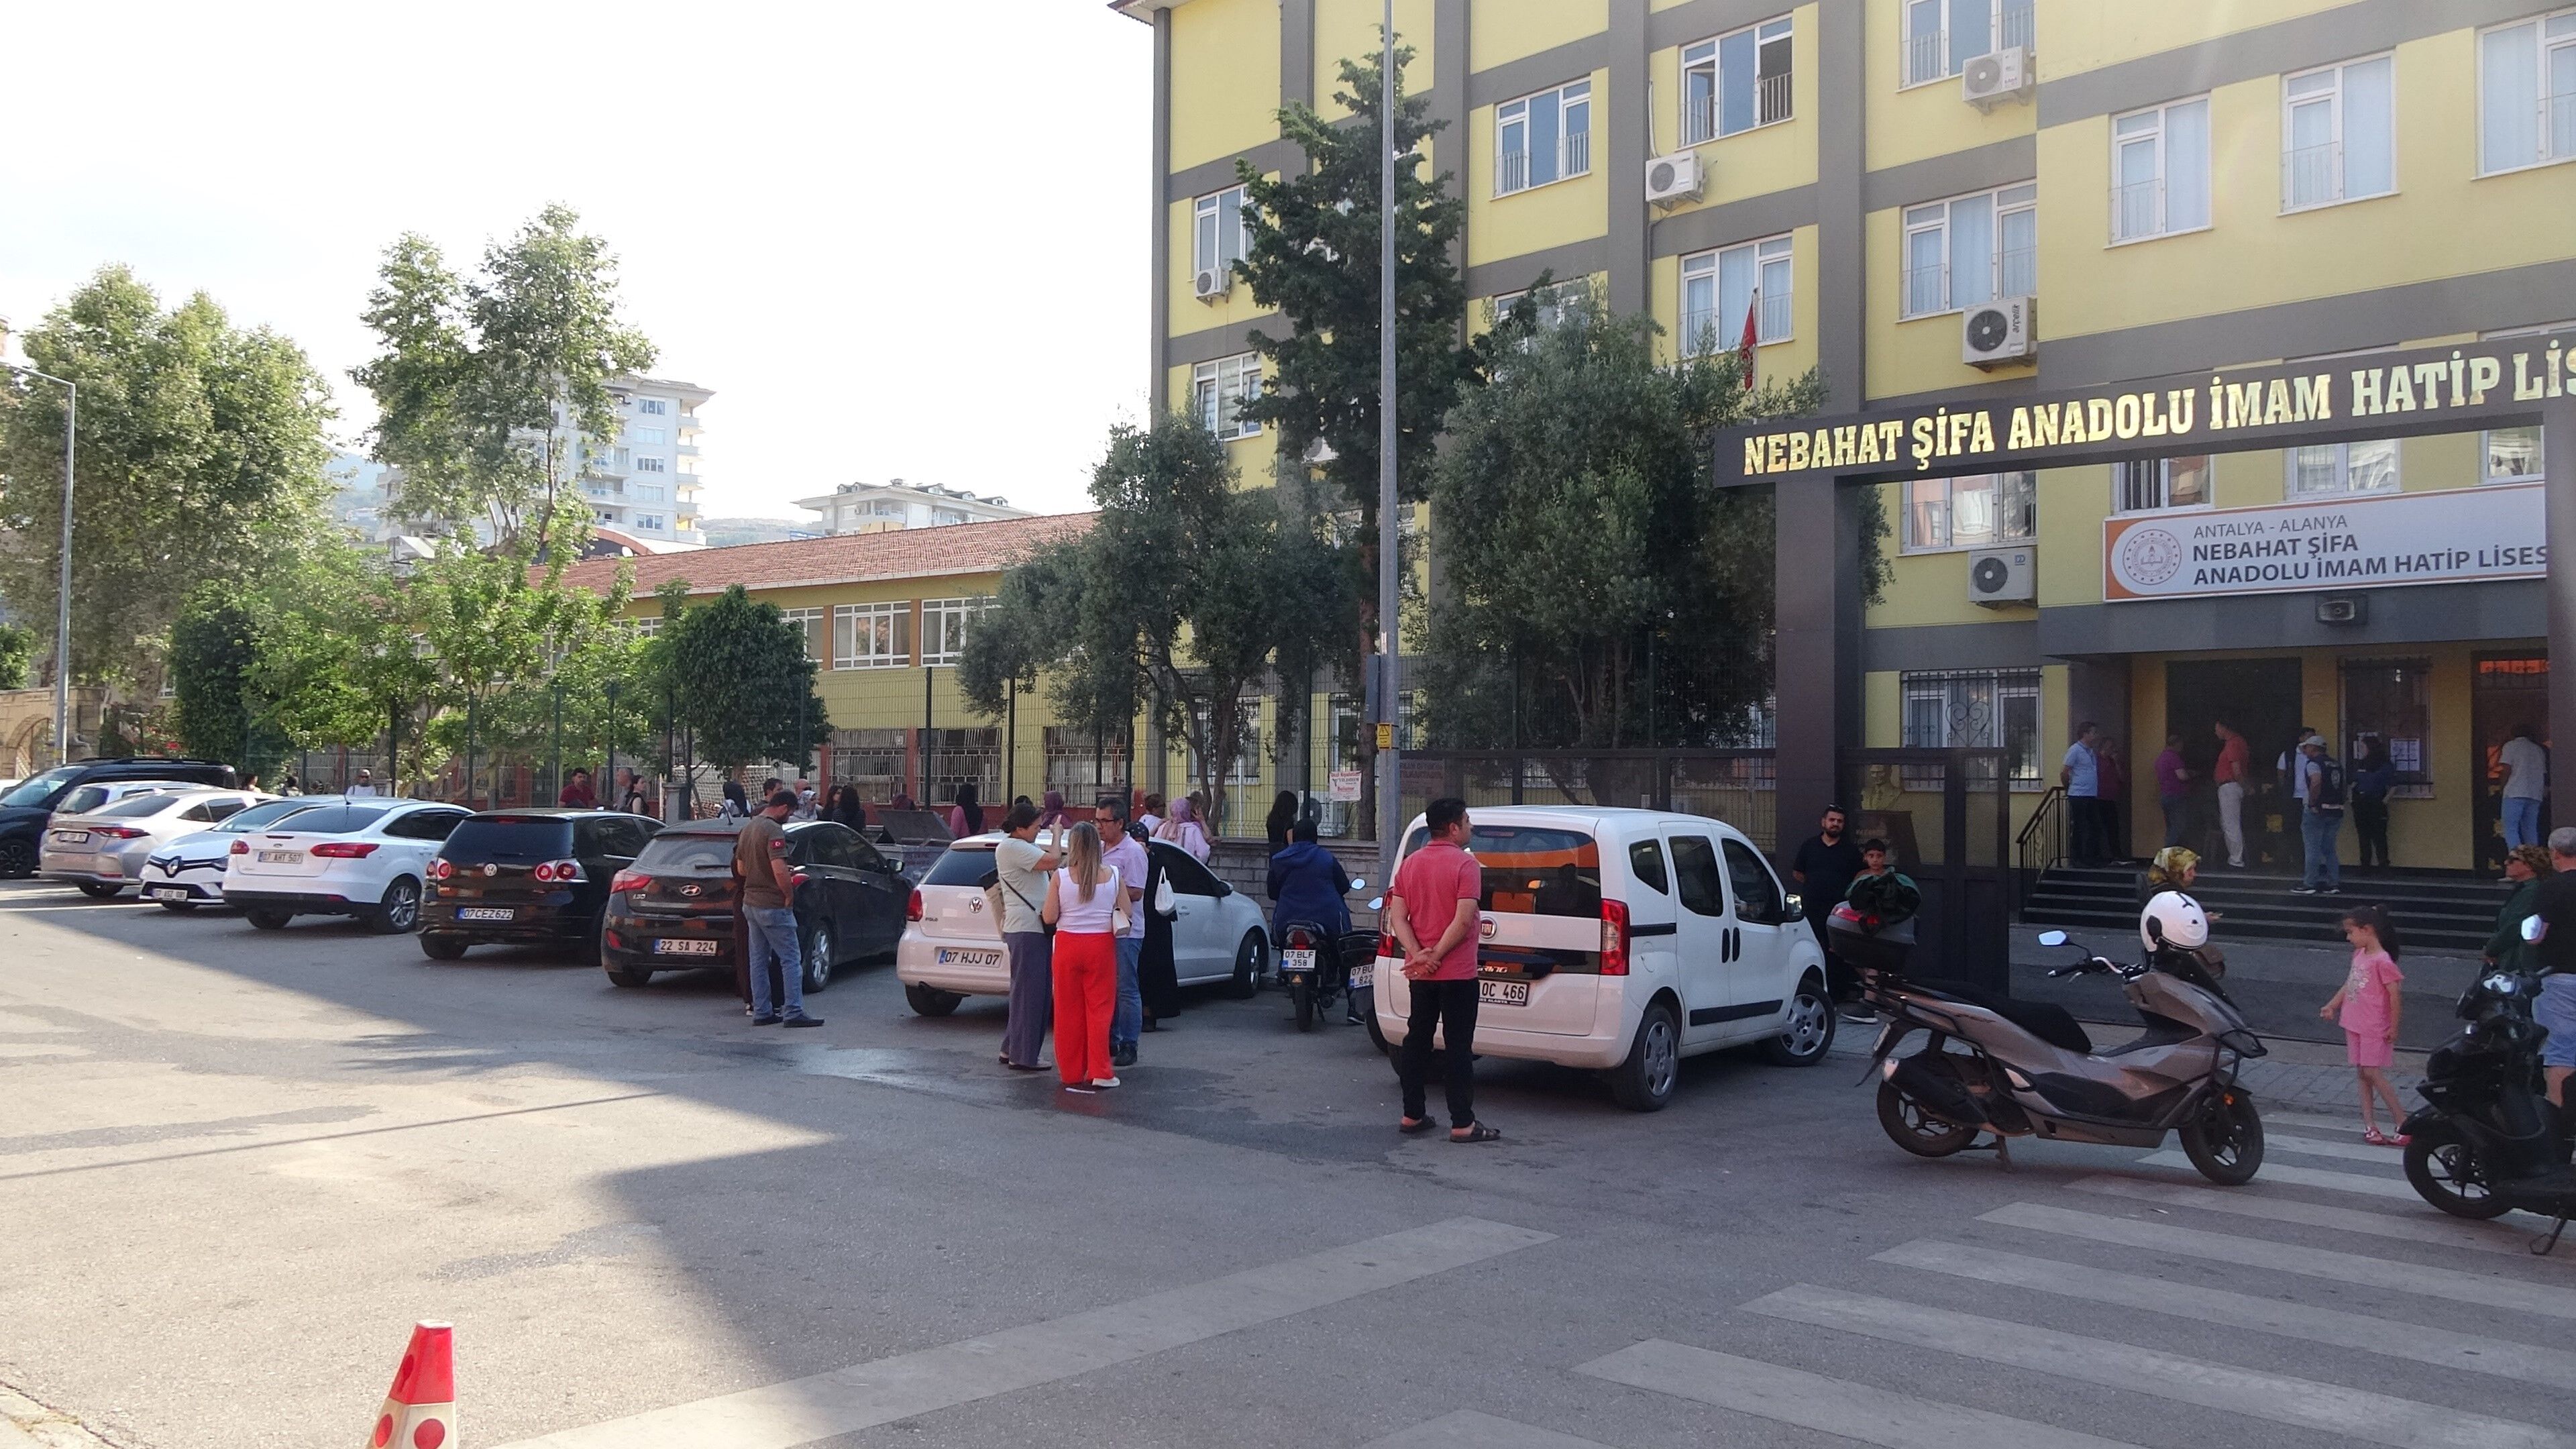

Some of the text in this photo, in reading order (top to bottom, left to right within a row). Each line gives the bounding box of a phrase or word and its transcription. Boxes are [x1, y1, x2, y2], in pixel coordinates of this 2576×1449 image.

[1744, 419, 1903, 475] NEBAHAT
[1911, 407, 1995, 470] ŞİFA
[2008, 388, 2196, 451] ANADOLU
[2209, 374, 2332, 430] İMAM
[2351, 351, 2500, 417] HATİP
[2193, 521, 2265, 539] ANTALYA
[2279, 515, 2348, 533] ALANYA
[2193, 538, 2301, 562] NEBAHAT
[2308, 532, 2359, 559] ŞİFA
[2194, 562, 2309, 586] ANADOLU
[2317, 557, 2387, 578] İMAM
[2394, 547, 2470, 574] HATİP
[661, 941, 715, 952] 22 SA 224
[945, 951, 1000, 965] 07 HJJ 07
[1285, 951, 1315, 959] 07 BLF
[1292, 959, 1307, 967] 358
[1352, 964, 1375, 976] 07 BU
[1503, 983, 1525, 1000] 466
